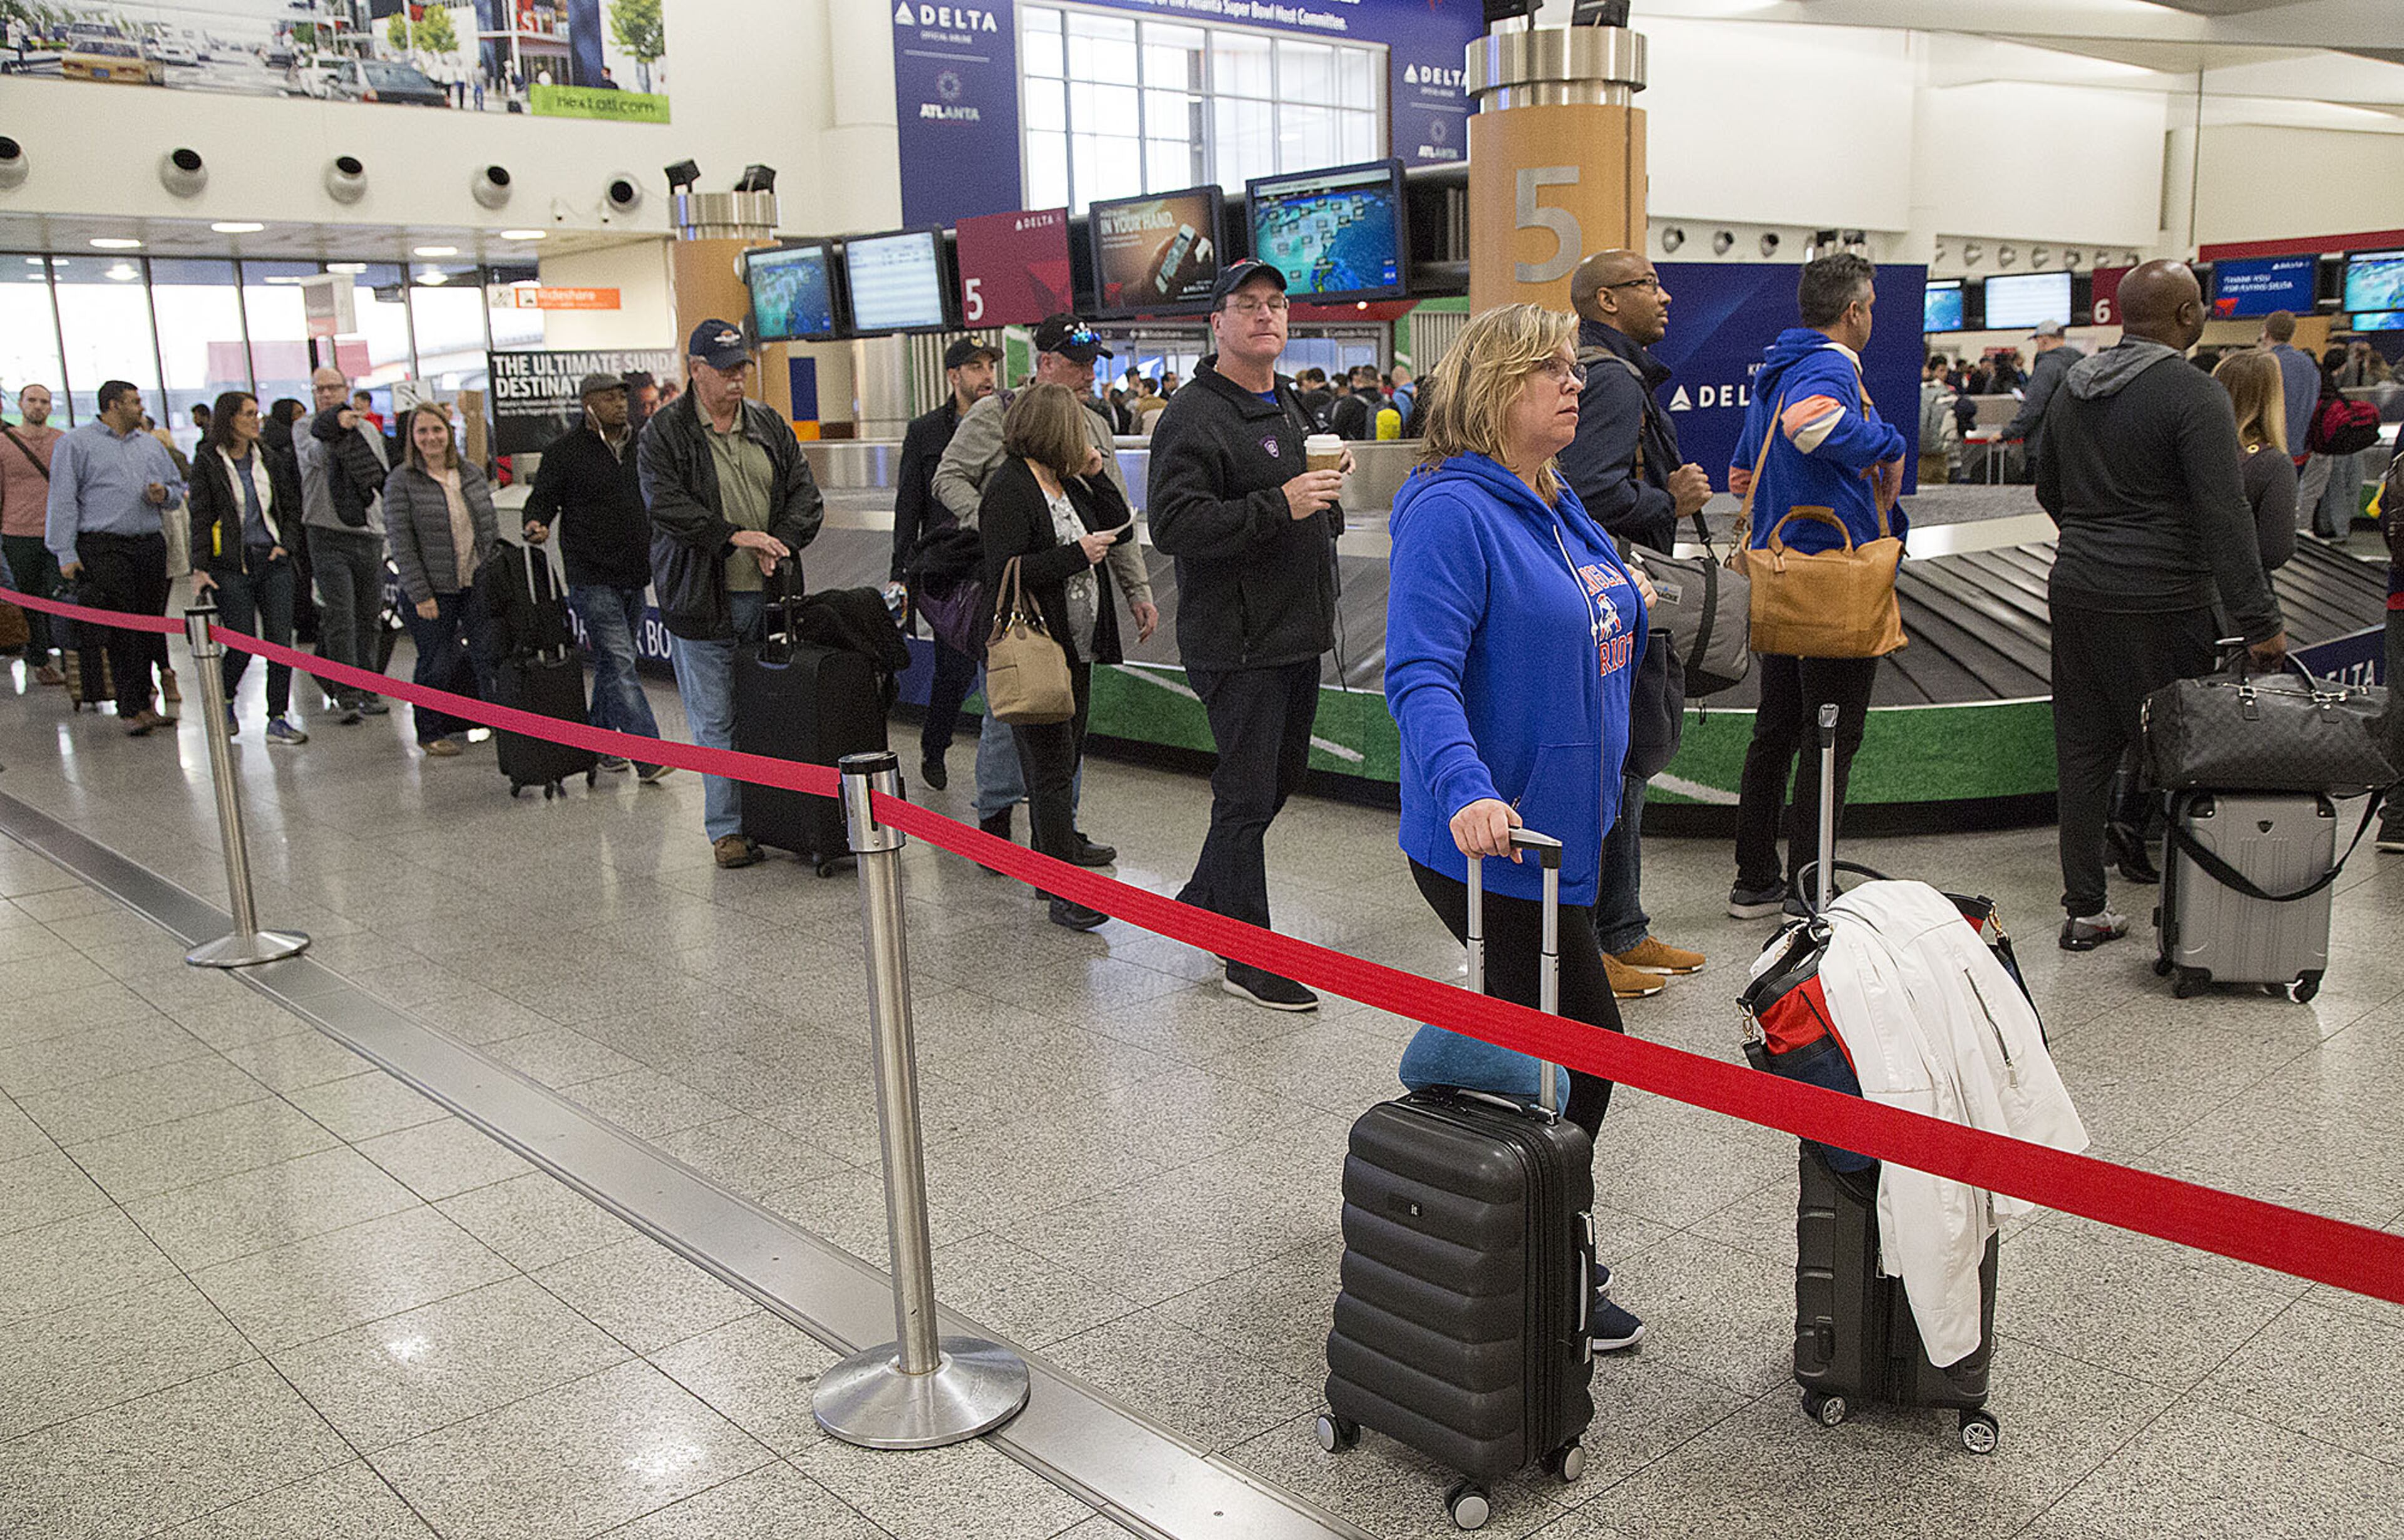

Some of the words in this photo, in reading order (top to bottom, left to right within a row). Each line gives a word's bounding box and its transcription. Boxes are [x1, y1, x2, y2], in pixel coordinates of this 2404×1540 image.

[920, 4, 998, 33] DELTA
[1223, 1, 1250, 19] Super
[1251, 1, 1275, 21] Bowl
[920, 103, 980, 121] ATLANTA
[1024, 215, 1054, 229] DELTA
[1514, 166, 1583, 284] 5
[965, 277, 985, 321] 5
[2093, 298, 2111, 324] 6
[492, 355, 530, 377] THE
[532, 352, 623, 376] ULTIMATE
[496, 376, 581, 399] DESTINAT
[1698, 384, 1756, 408] DEL
